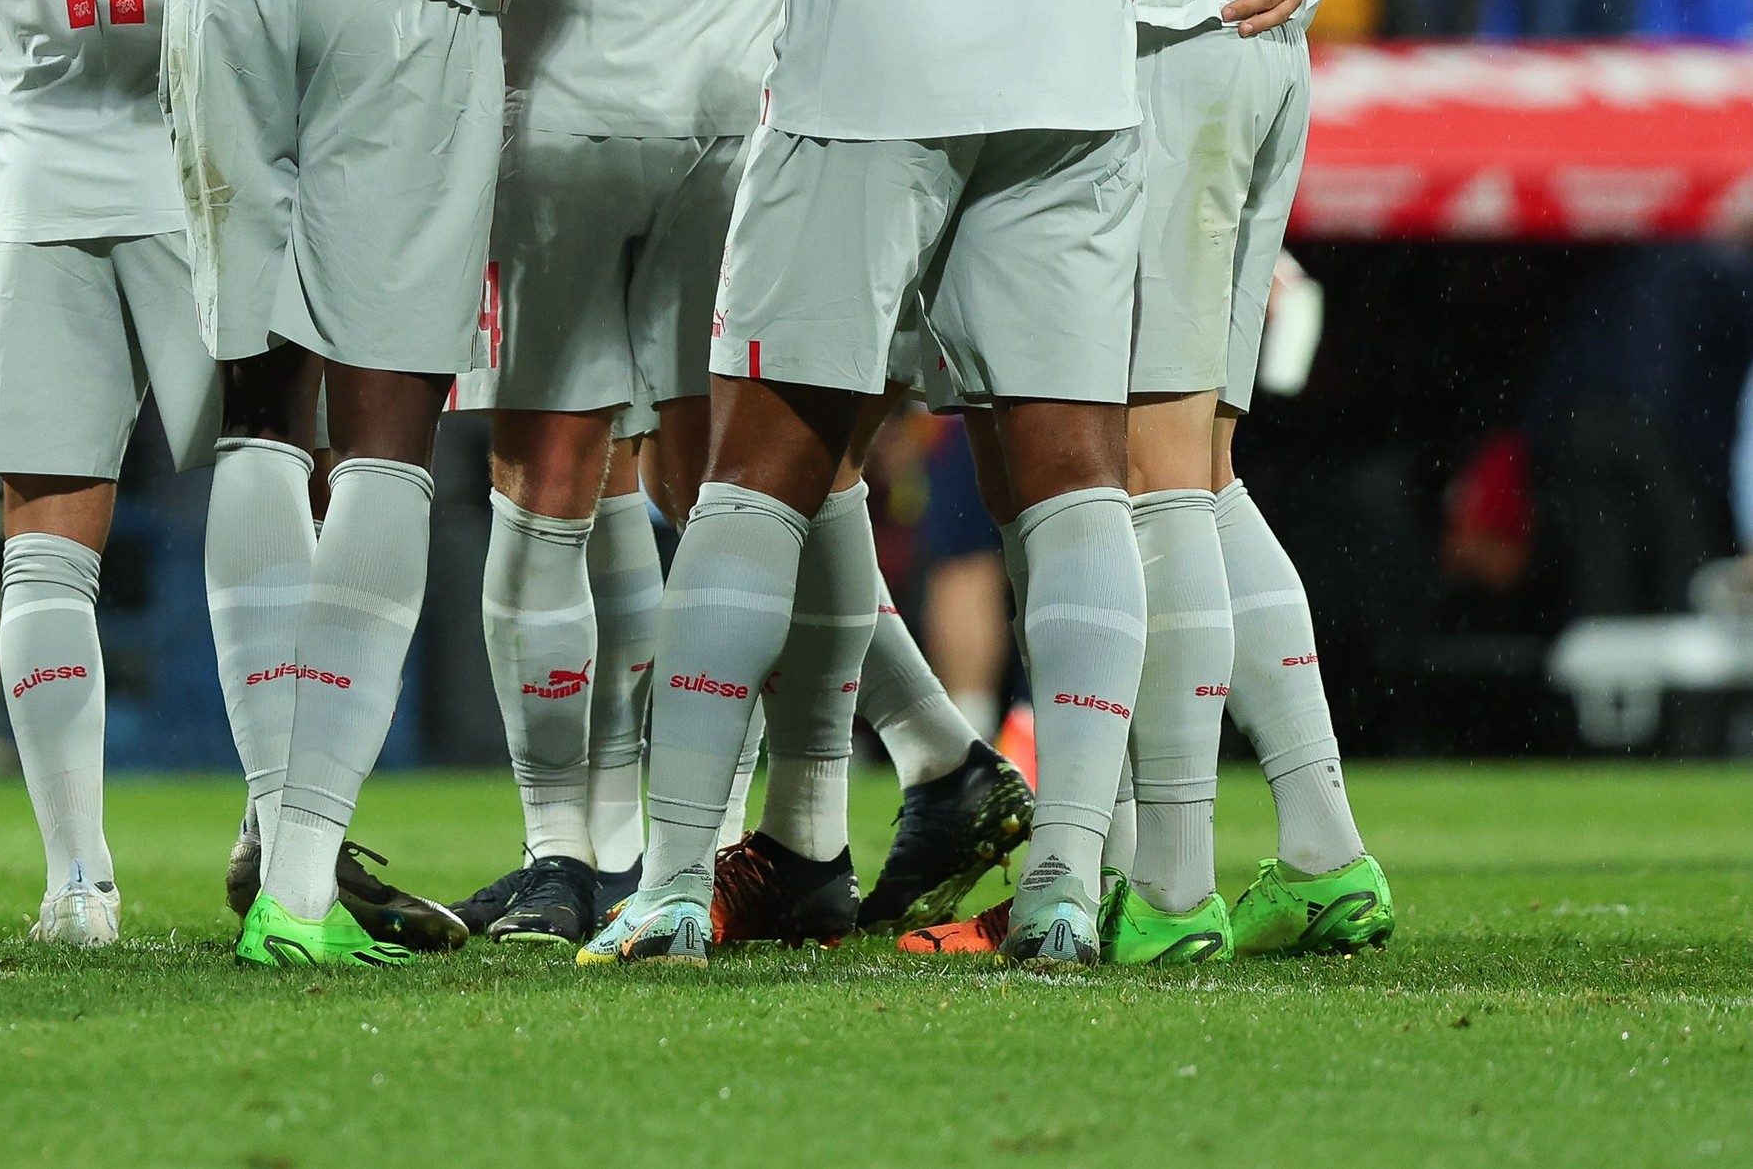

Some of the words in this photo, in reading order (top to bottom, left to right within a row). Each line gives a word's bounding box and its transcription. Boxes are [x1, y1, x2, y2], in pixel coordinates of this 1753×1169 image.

[1282, 653, 1319, 667] suis
[13, 666, 87, 699] suisse
[246, 663, 296, 686] suis
[296, 664, 352, 690] uisse
[670, 671, 749, 700] suisse
[1054, 691, 1131, 720] suisse
